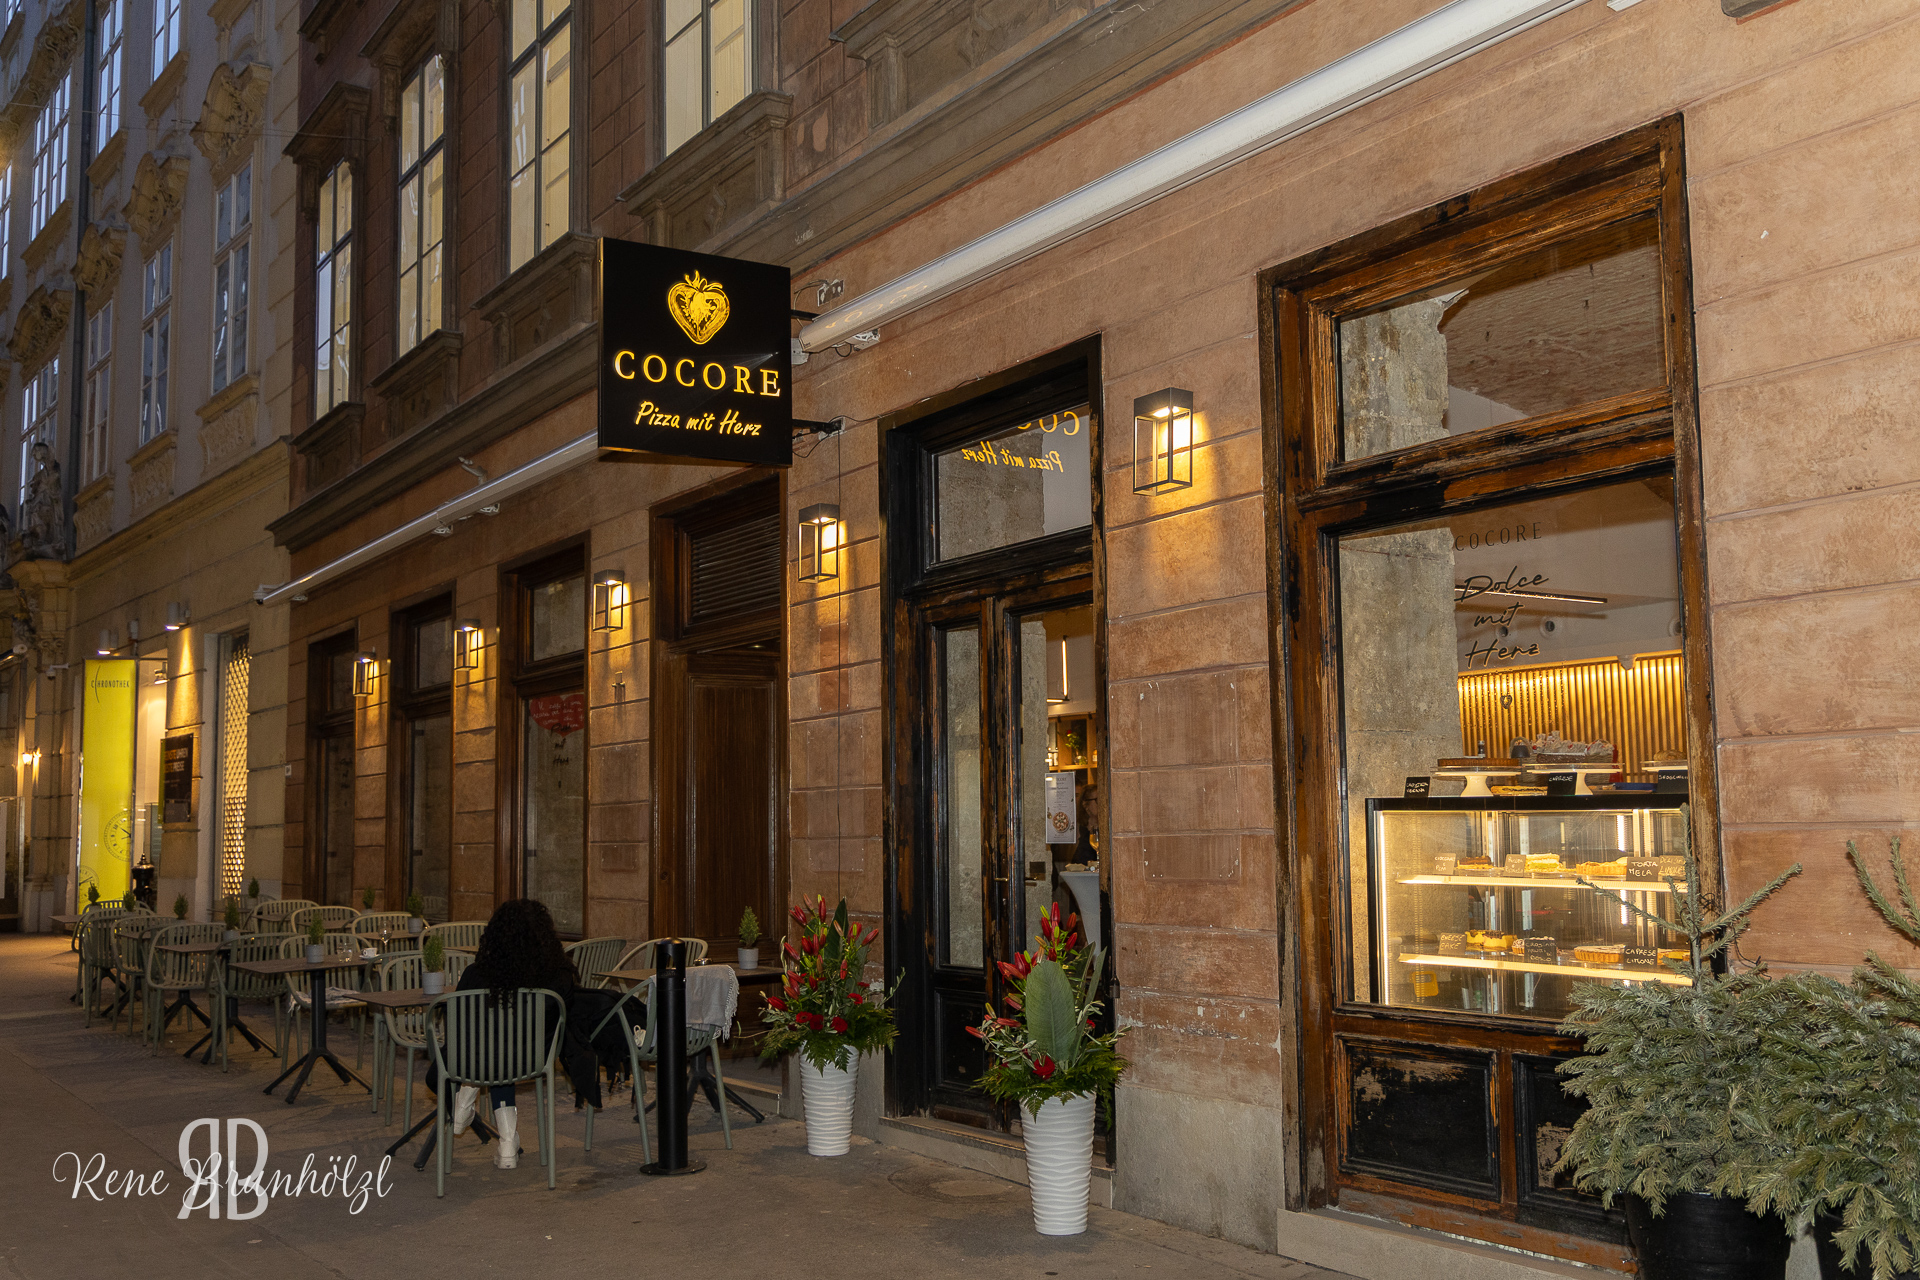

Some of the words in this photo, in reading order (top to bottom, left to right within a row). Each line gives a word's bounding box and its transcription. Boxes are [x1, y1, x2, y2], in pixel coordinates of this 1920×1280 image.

[614, 350, 781, 397] COCORE
[635, 400, 680, 428] Pizza
[686, 412, 716, 431] mit
[719, 409, 762, 436] Herz
[1454, 521, 1542, 551] COCORE
[1454, 565, 1549, 602] Dolce
[1474, 601, 1524, 628] mit
[1465, 638, 1540, 669] Herz
[1628, 867, 1653, 877] MELA
[1625, 947, 1657, 957] CAPRESE
